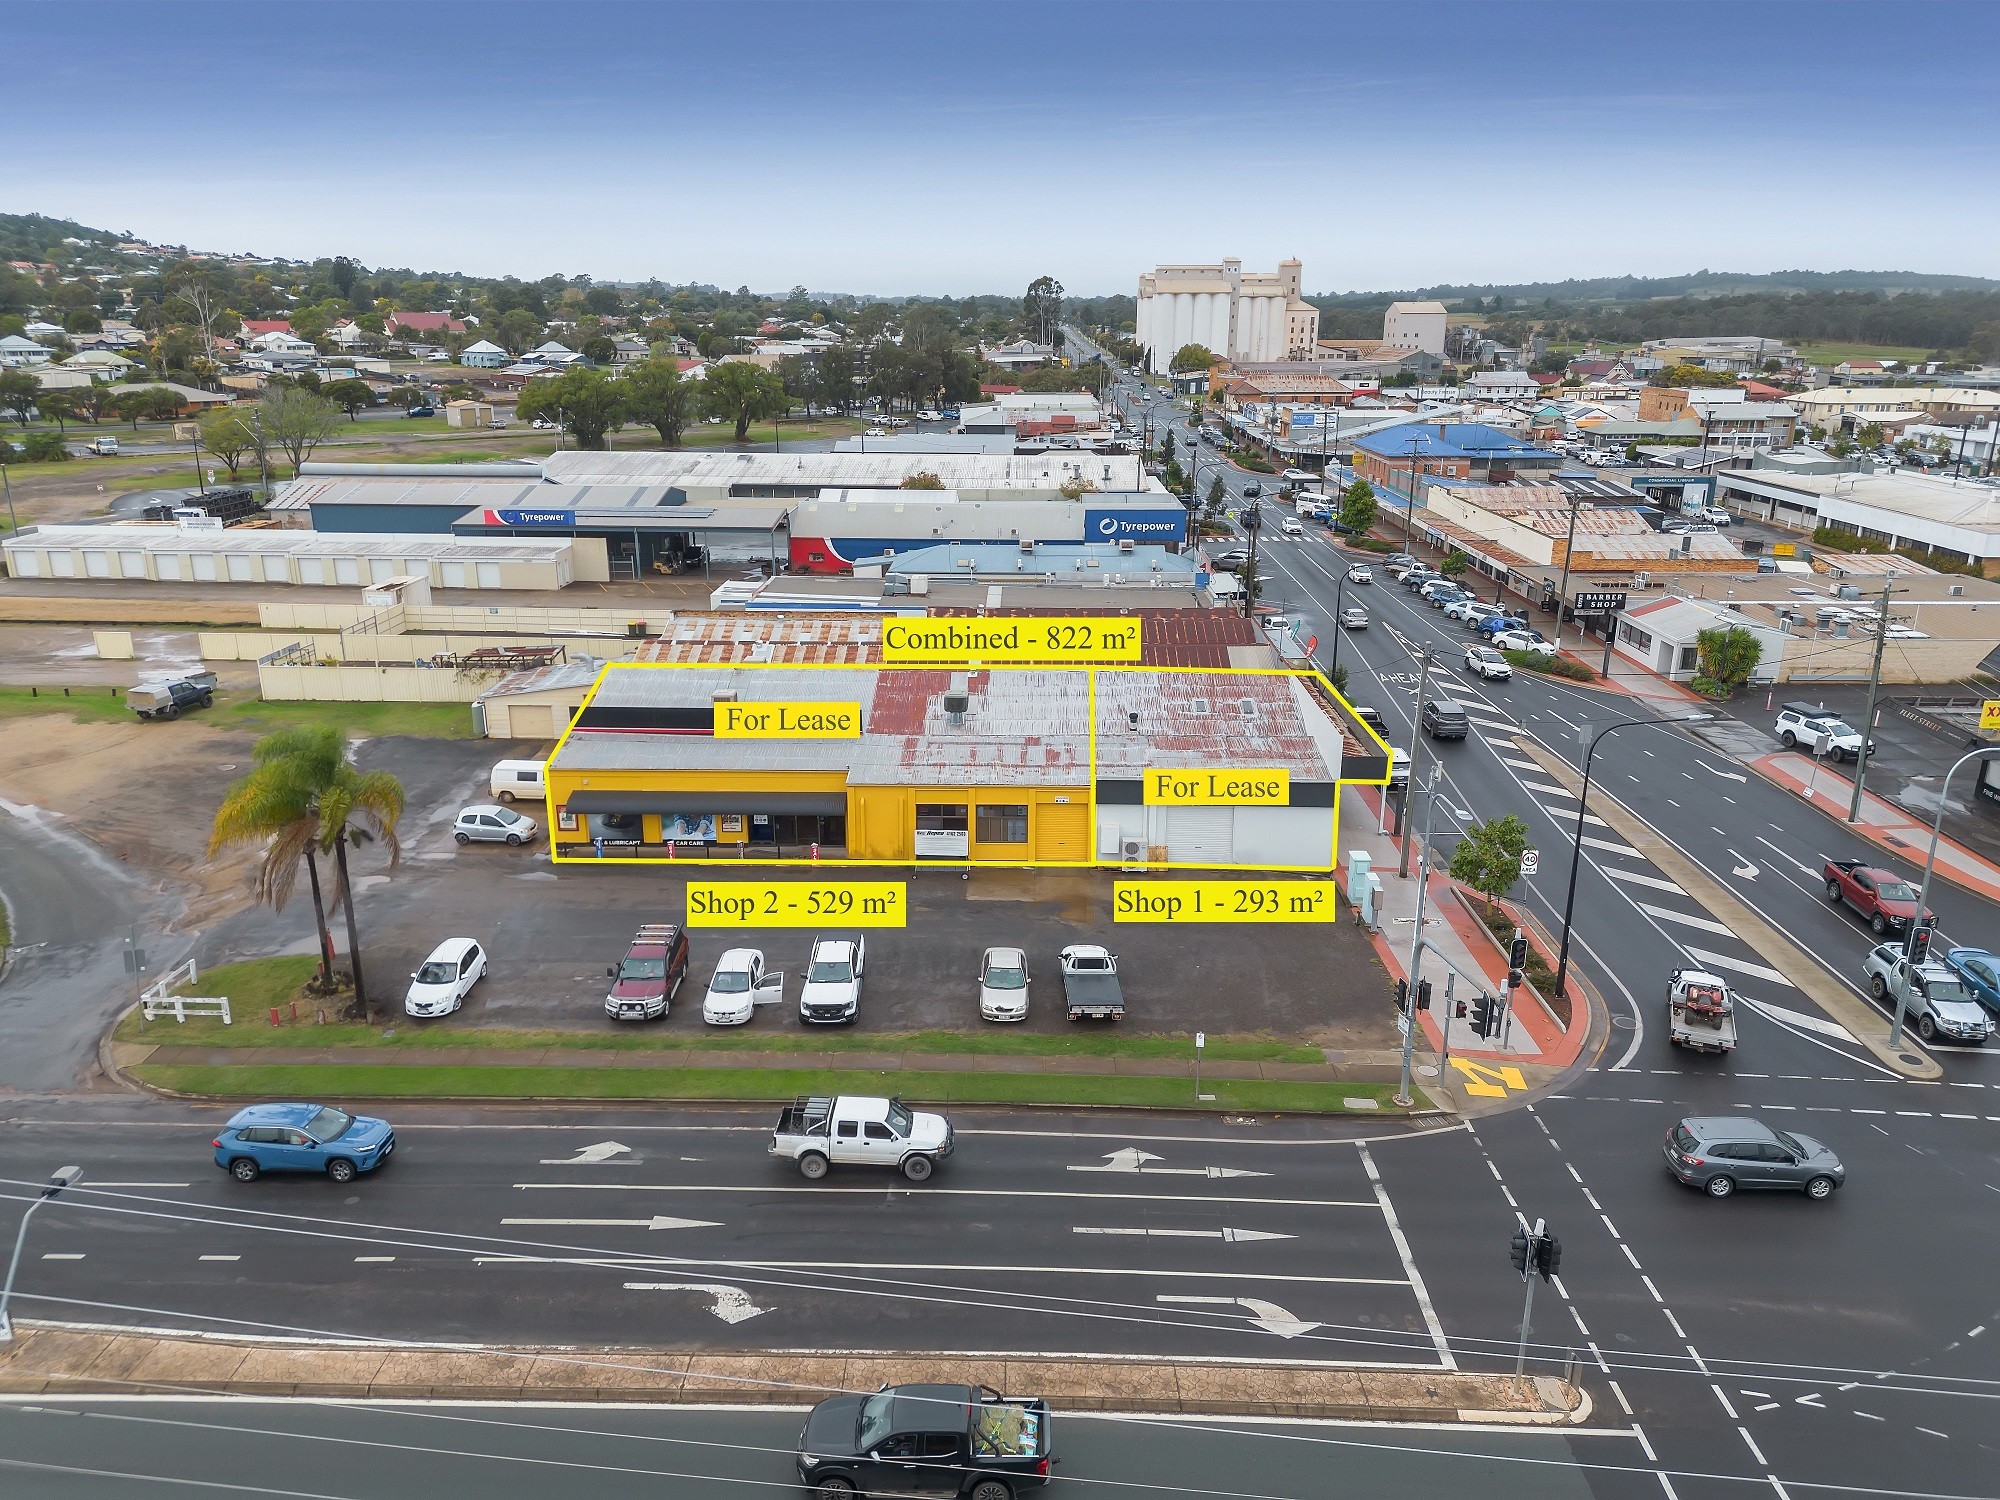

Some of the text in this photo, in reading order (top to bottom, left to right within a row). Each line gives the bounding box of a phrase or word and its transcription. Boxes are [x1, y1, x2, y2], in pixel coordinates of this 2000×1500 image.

[520, 512, 564, 523] Tyrepower
[1120, 521, 1175, 533] Tyrepower
[1585, 593, 1623, 601] BARBER
[1899, 708, 1942, 732] FLEET STREET
